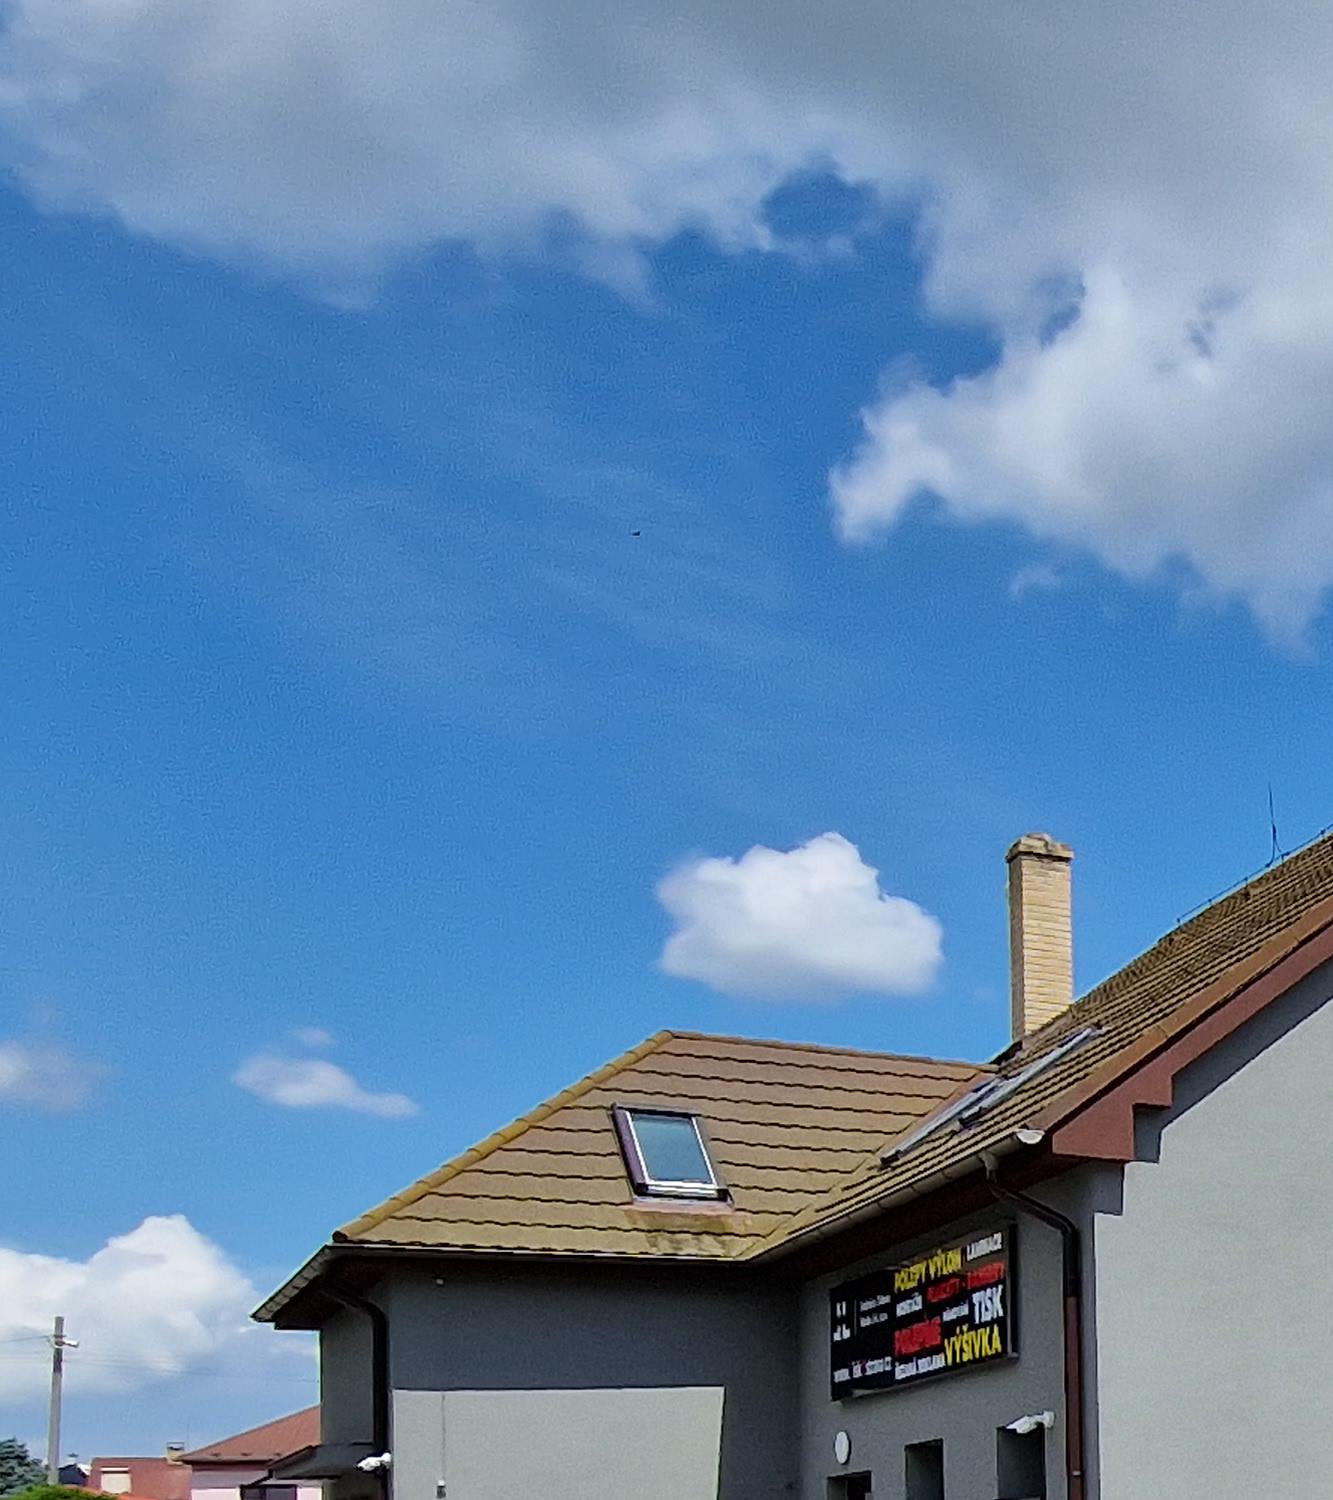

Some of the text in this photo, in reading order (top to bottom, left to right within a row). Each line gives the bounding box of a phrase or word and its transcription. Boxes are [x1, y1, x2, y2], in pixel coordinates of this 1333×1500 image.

[894, 1261, 927, 1293] POLEPY
[973, 1285, 1004, 1324] TISK
[944, 1324, 1002, 1366] VÝŠIVKA
